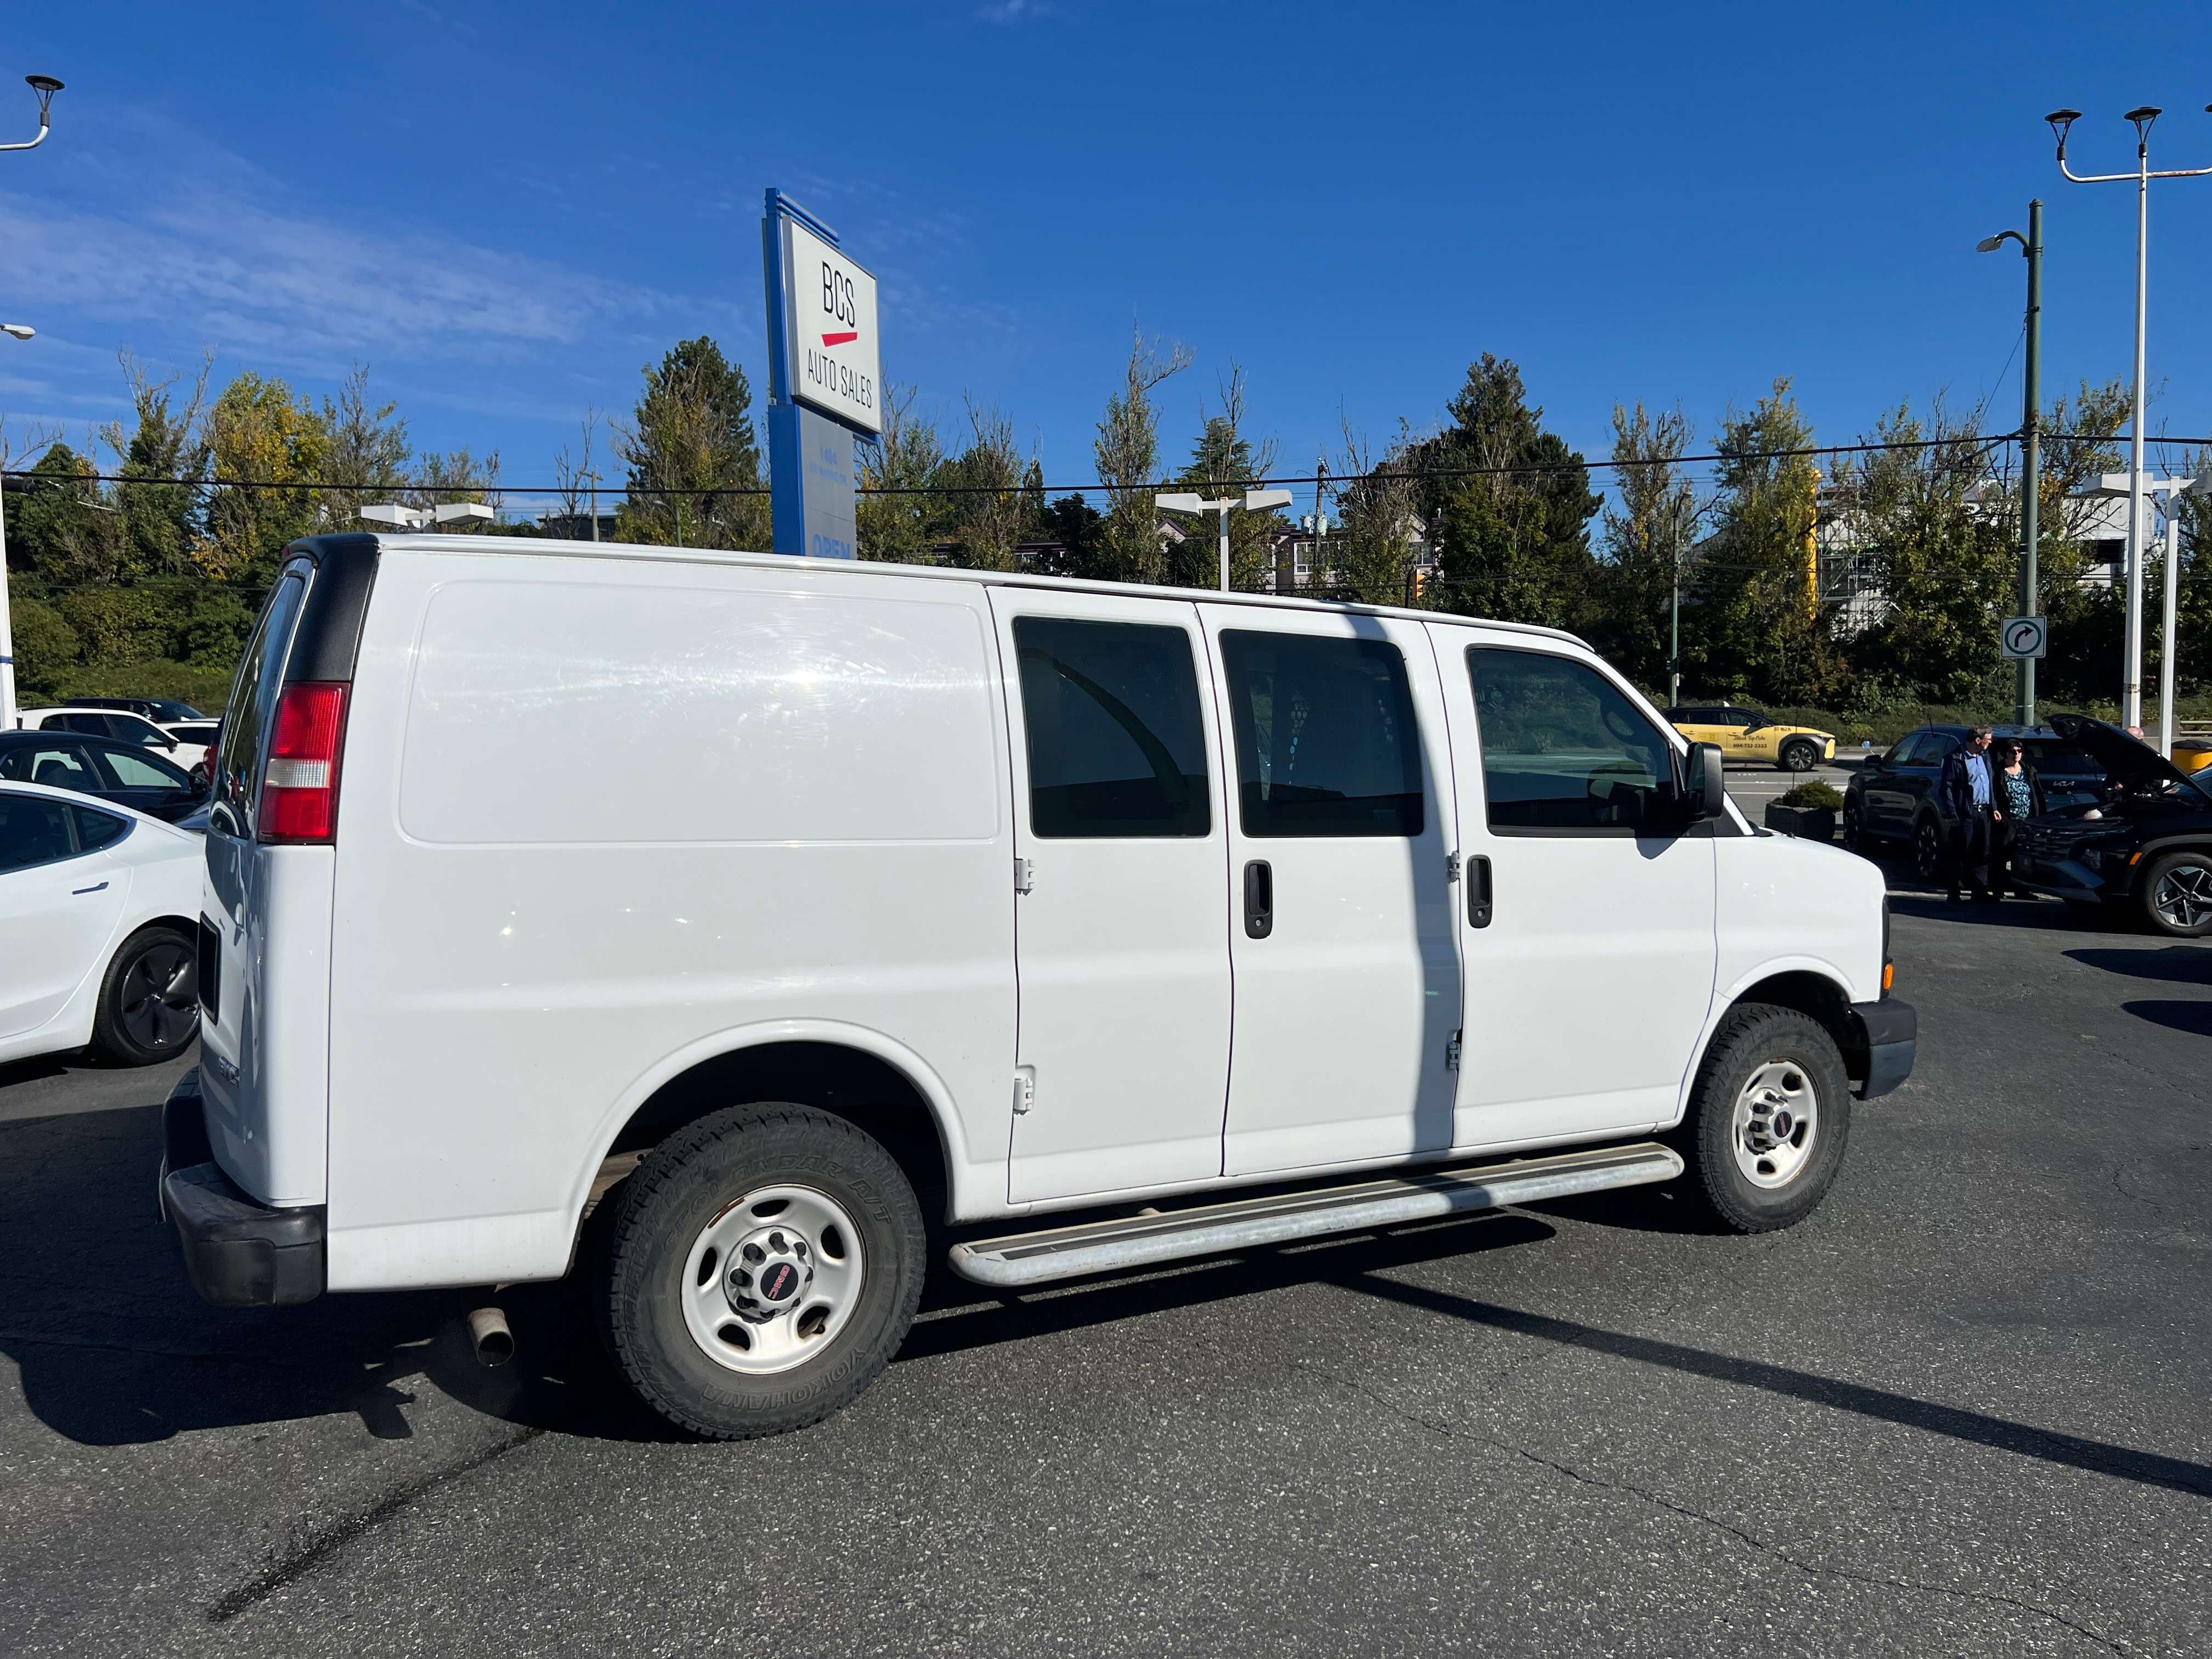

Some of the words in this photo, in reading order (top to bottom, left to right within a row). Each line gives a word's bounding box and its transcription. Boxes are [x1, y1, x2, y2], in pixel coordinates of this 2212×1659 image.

[822, 261, 855, 328] BCS
[808, 348, 836, 391] AUTO
[841, 365, 872, 409] SALES
[813, 534, 851, 558] OPEN
[847, 1179, 891, 1225] A/T
[768, 1265, 790, 1300] GMC
[702, 1347, 866, 1411] YOKOHAMA
